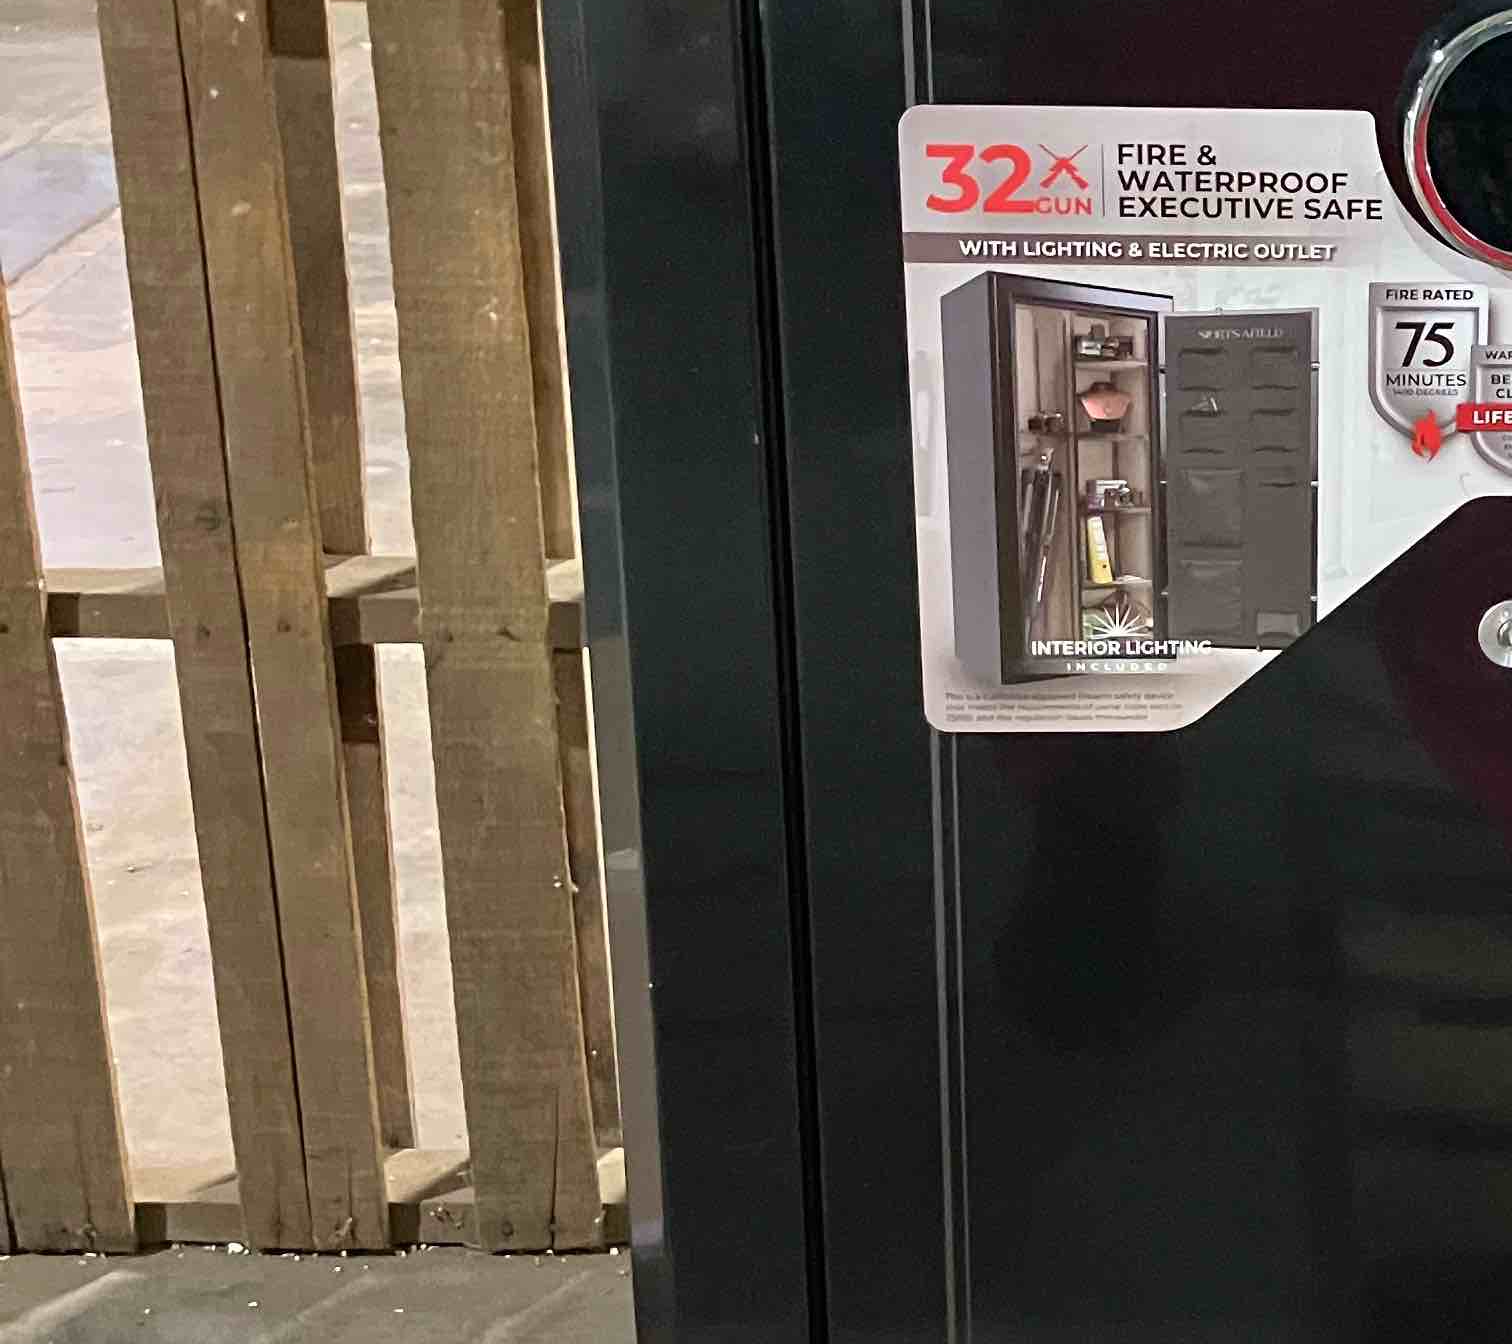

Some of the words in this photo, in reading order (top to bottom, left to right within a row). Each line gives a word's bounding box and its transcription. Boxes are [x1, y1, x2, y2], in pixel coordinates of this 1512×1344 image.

[1118, 142, 1187, 167] FIRE
[1197, 144, 1217, 167] &
[925, 143, 1037, 214] 32
[1118, 169, 1349, 195] WATERPROOF
[1036, 197, 1093, 216] GUN
[1118, 196, 1298, 220] EXECUTIVE
[1303, 197, 1384, 221] SAFE
[958, 239, 1018, 258] WITH
[1023, 240, 1124, 259] LIGHTING
[1128, 241, 1144, 258] &
[1148, 242, 1251, 260] ELECTRIC
[1254, 243, 1338, 261] OUTLET
[1385, 288, 1418, 302] FIRE
[1424, 288, 1473, 301] RATED
[1395, 321, 1455, 368] 75
[1386, 373, 1467, 387] MINUTES
[1030, 639, 1120, 657] INTERIOR
[1125, 639, 1212, 657] LIGHTING
[1066, 662, 1168, 672] INCLUDED
